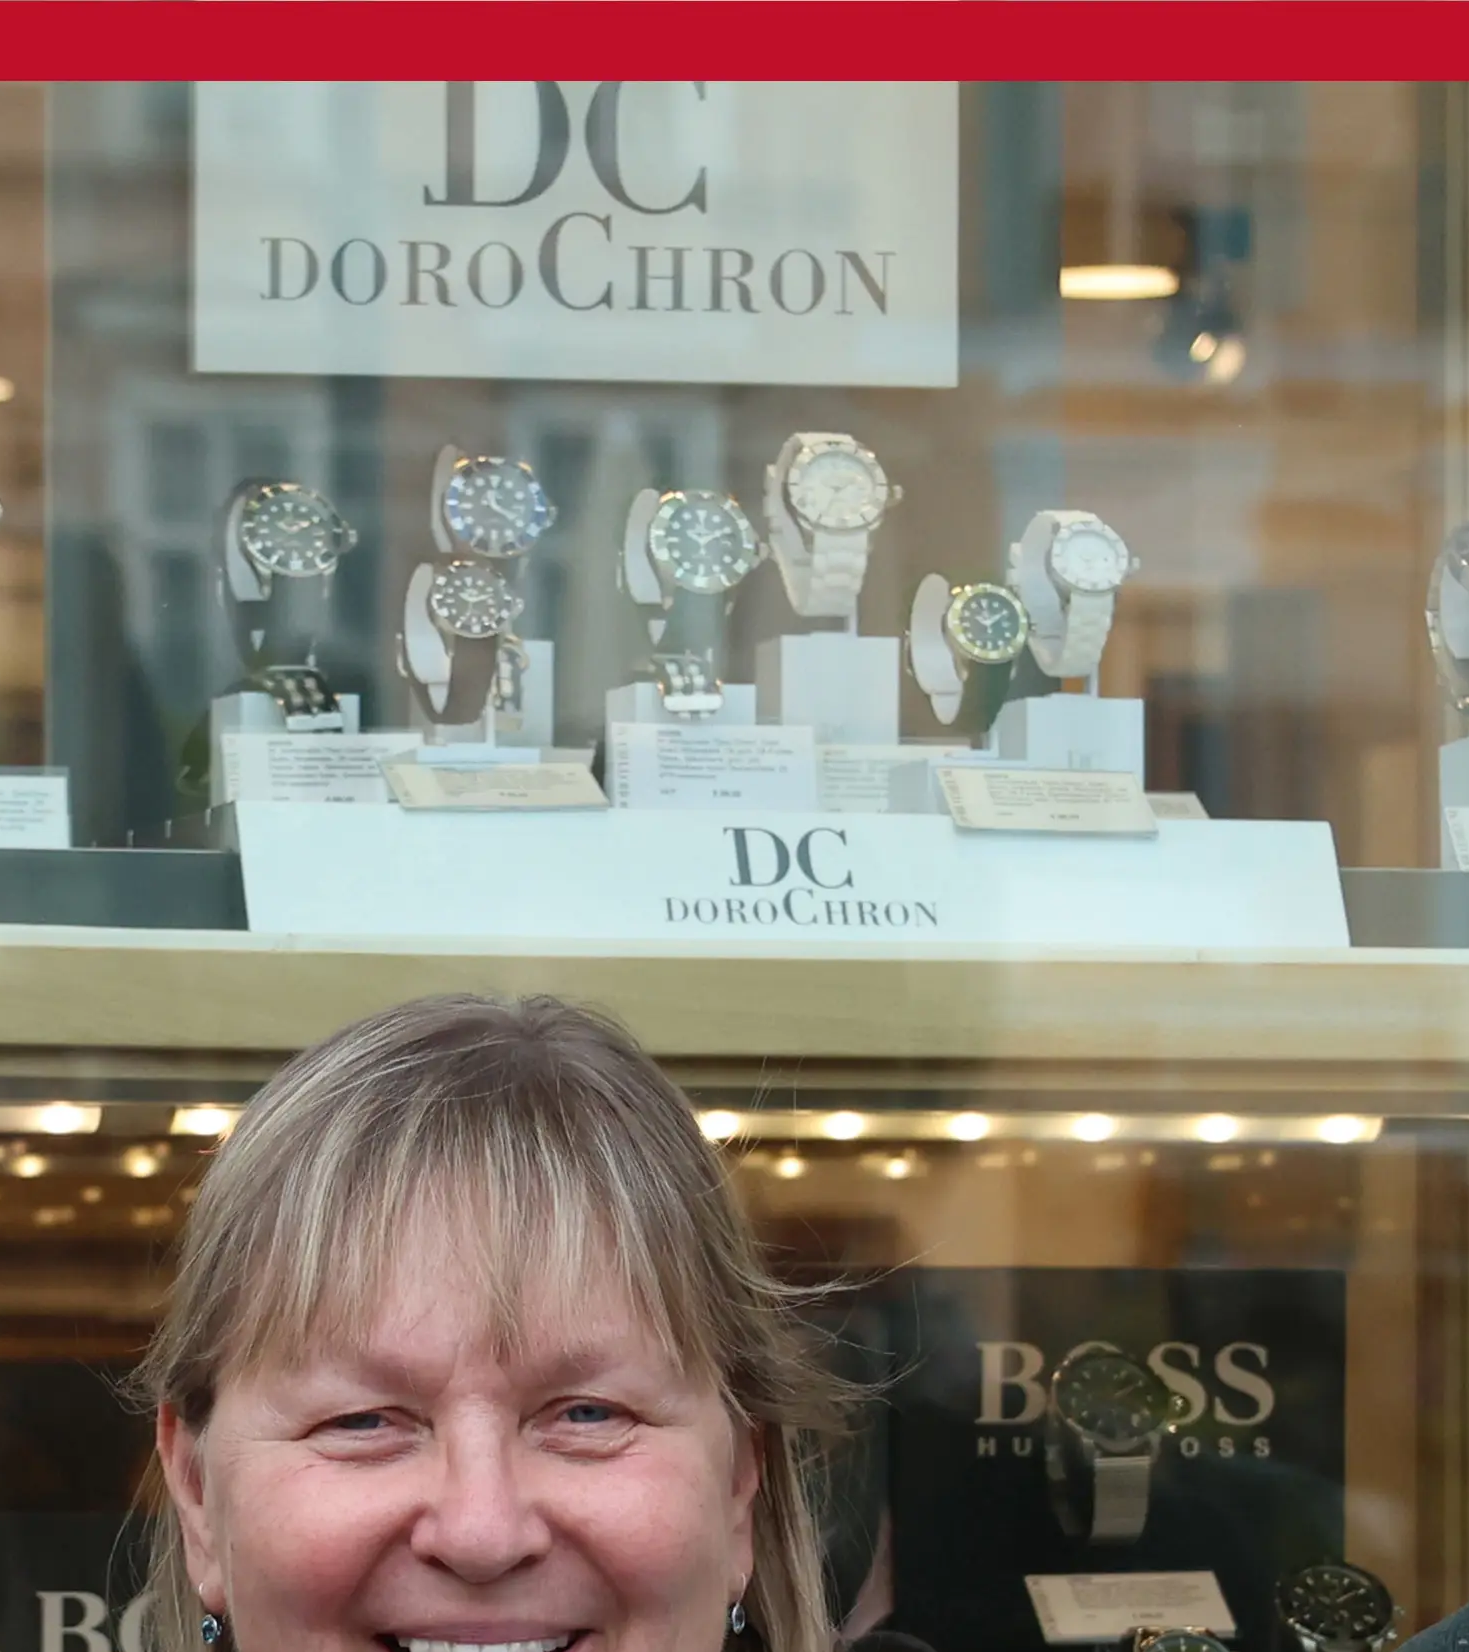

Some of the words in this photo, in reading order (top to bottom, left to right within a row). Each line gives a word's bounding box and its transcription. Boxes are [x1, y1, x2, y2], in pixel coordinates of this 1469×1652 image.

[423, 82, 708, 214] DC
[723, 826, 854, 889] DC
[974, 1341, 1275, 1425] BSS
[1179, 1437, 1271, 1458] OSS
